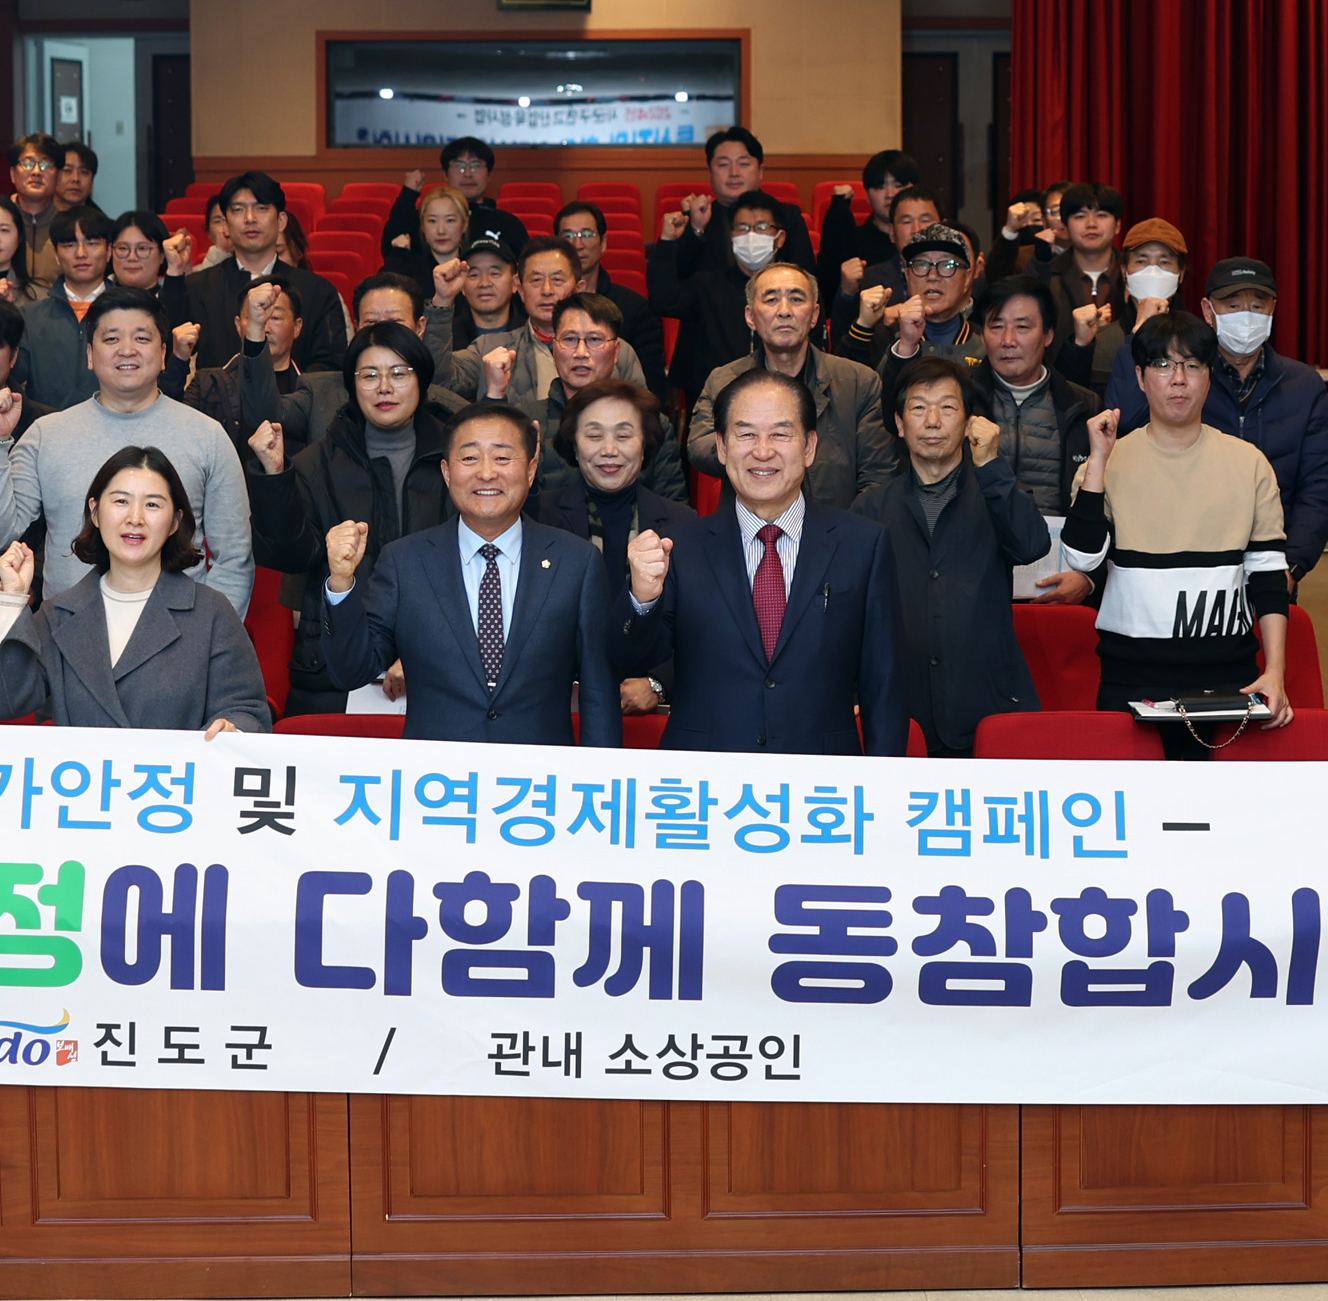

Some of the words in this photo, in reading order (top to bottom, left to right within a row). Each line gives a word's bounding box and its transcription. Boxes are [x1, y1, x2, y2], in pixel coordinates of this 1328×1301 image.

[234, 766, 296, 835] 및
[334, 768, 874, 855] 지역경제활성화
[906, 789, 1128, 859] 캠페인
[295, 870, 704, 1000] 다함께
[488, 1031, 582, 1078] 관내
[605, 1033, 800, 1081] 소상공인
